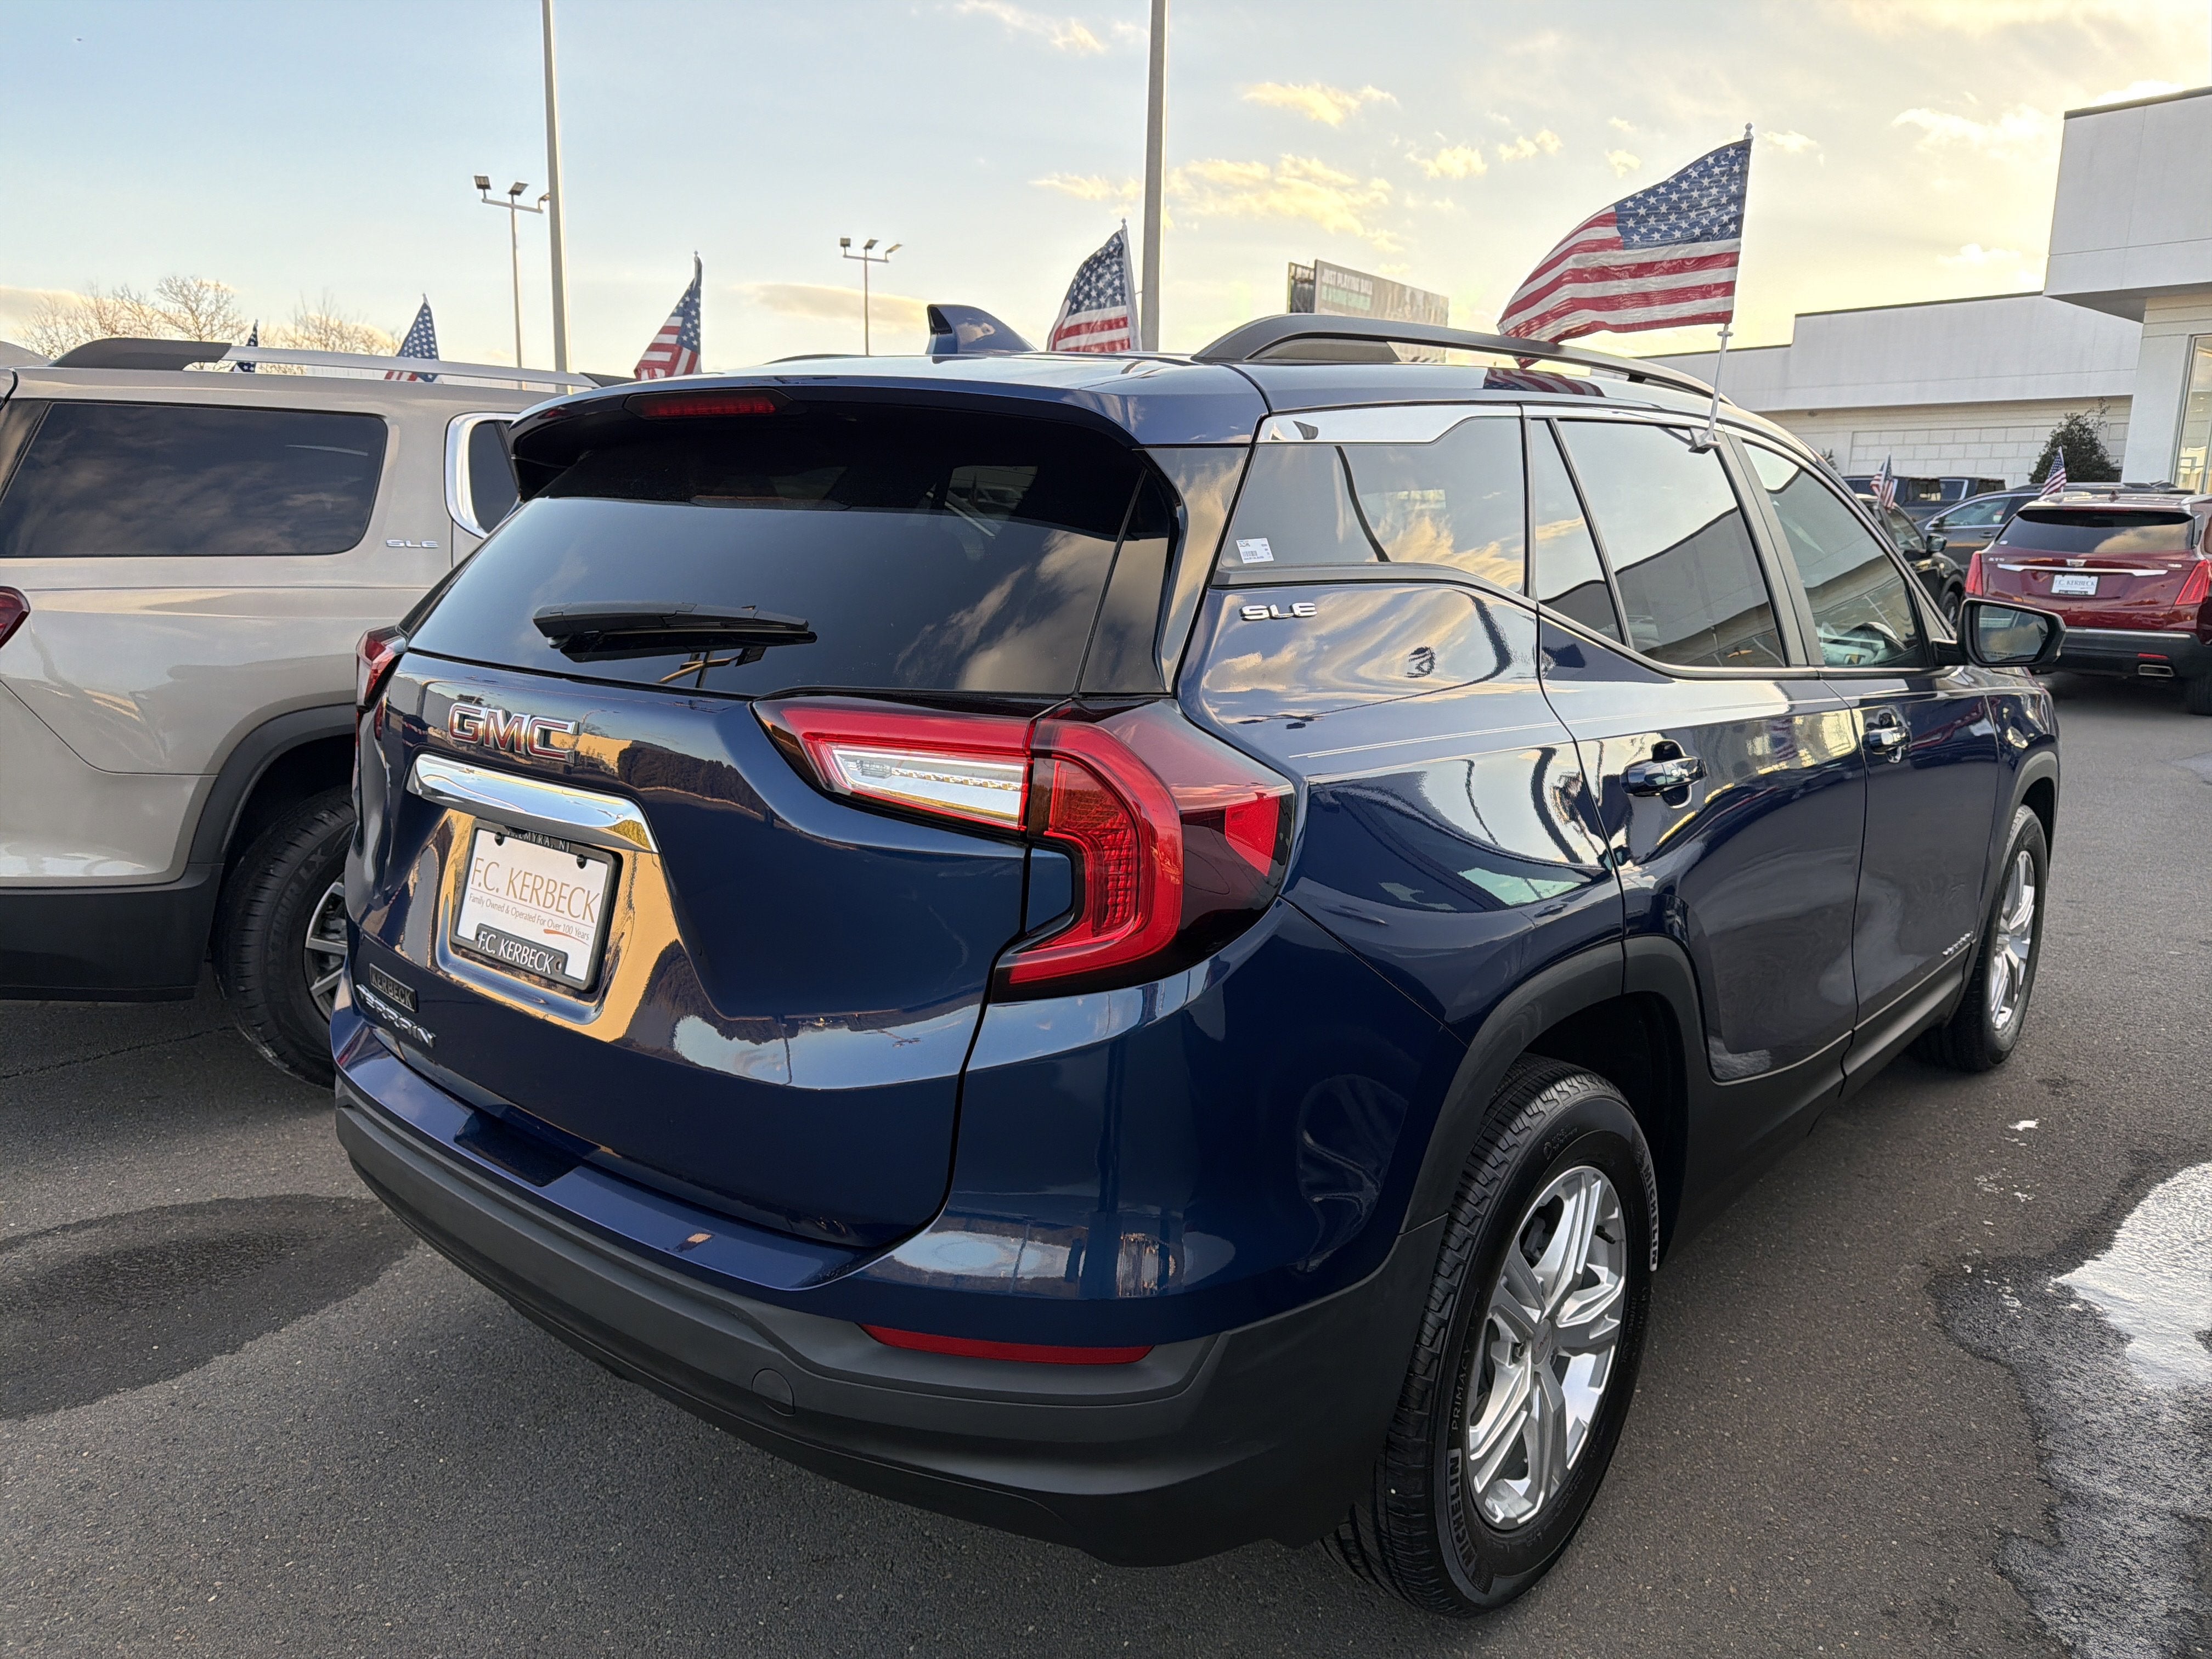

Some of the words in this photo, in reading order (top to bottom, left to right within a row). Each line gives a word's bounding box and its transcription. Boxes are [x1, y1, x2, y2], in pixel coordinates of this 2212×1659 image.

[386, 539, 439, 549] SLE
[1239, 601, 1318, 622] SLE
[448, 702, 579, 764] GMC
[559, 840, 571, 853] NJ
[469, 893, 486, 907] Family
[486, 899, 504, 913] Owned
[511, 907, 536, 926] Operated
[537, 915, 546, 926] For
[547, 919, 561, 930] Over
[562, 924, 573, 935] 100
[574, 927, 590, 941] Years
[470, 856, 500, 893] F.C.
[506, 867, 600, 924] KERBECK
[478, 930, 496, 955] F.C.
[498, 938, 555, 975] KERBECK
[356, 984, 437, 1048] TERRAIN
[371, 970, 413, 1008] KERBECK
[1644, 1164, 1658, 1265] MICHELIN
[1451, 1342, 1471, 1430] PRIMACY
[1449, 1455, 1477, 1568] MICHELIN
